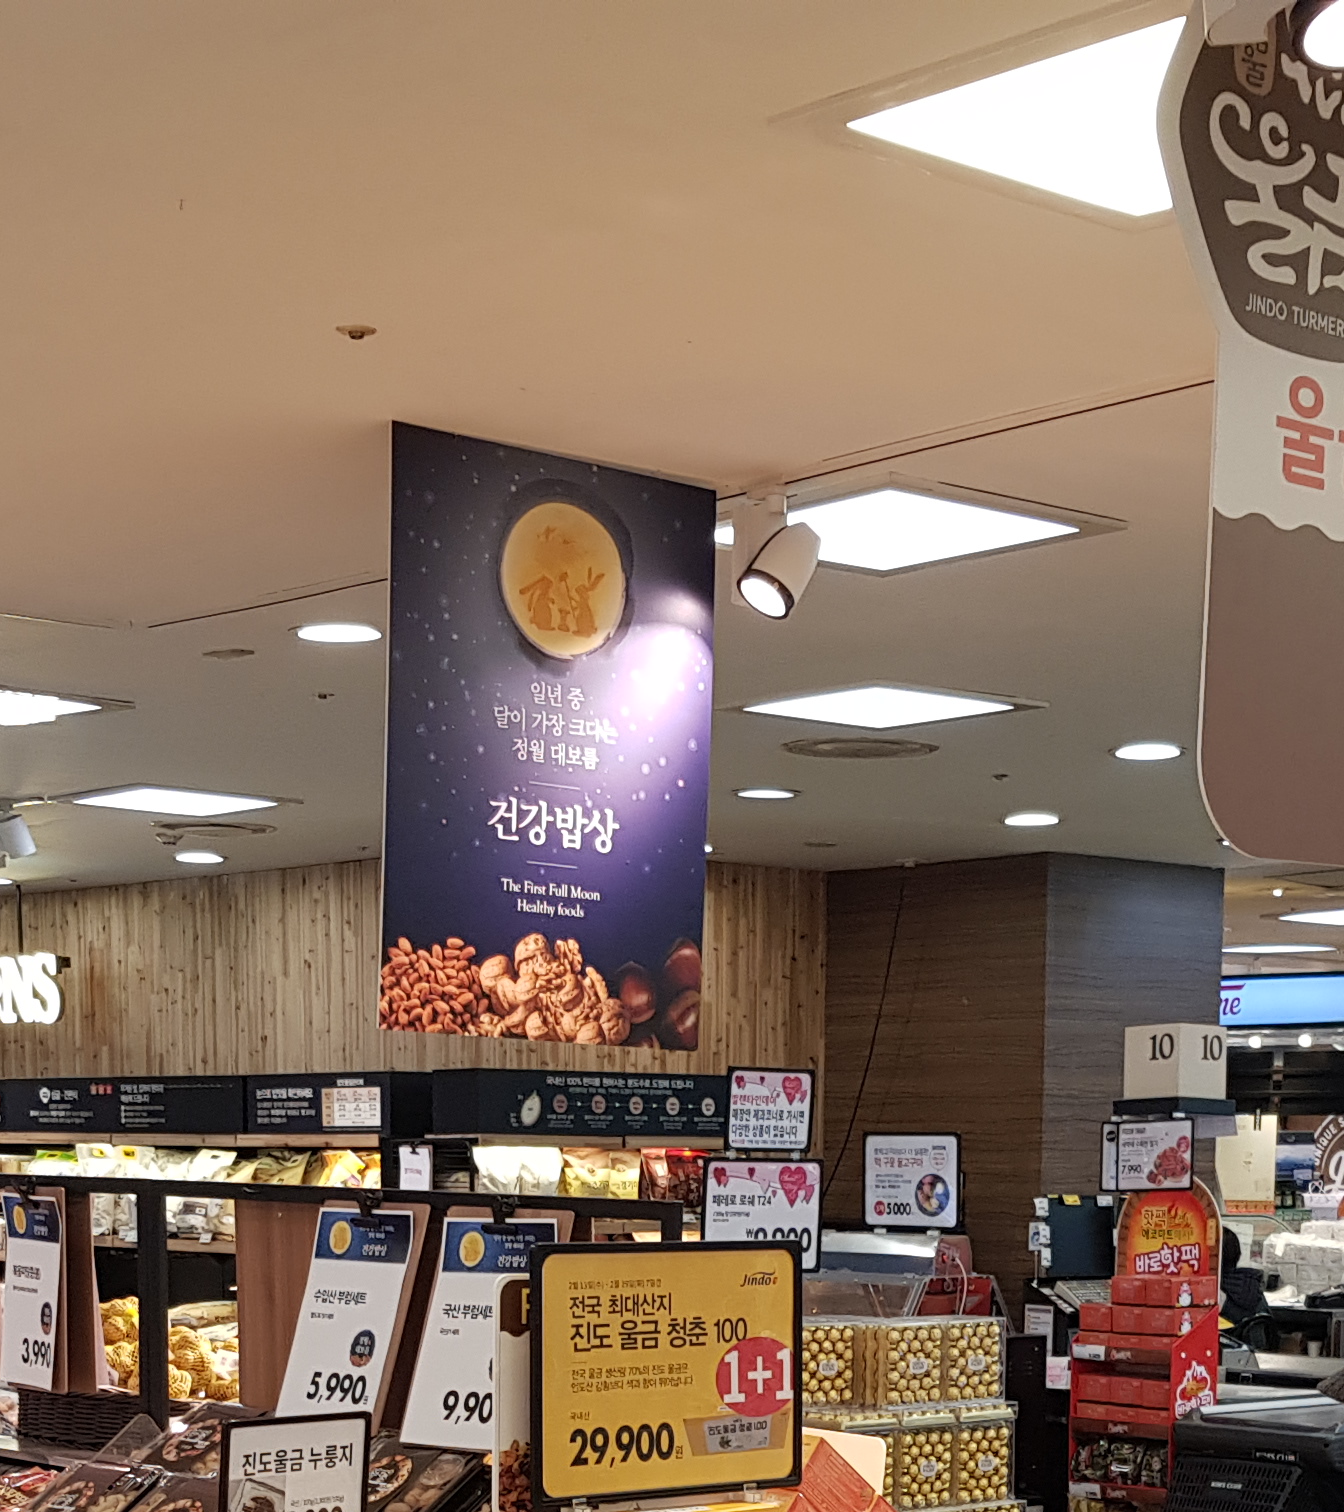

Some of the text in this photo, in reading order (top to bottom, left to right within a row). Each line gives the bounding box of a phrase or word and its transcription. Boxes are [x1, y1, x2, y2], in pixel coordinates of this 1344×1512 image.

[1245, 292, 1288, 321] JINDO
[530, 681, 585, 711] 일년 중
[493, 705, 526, 732] 달이
[531, 713, 566, 737] 가장
[512, 738, 600, 770] 정월 대보름
[487, 796, 620, 854] 건강밥상
[500, 877, 601, 901] The First Full Moon
[517, 899, 585, 918] Healthy foods
[1148, 1032, 1175, 1061] 10
[1201, 1034, 1224, 1061] 10
[569, 1292, 672, 1319] 전국 최대산지
[570, 1316, 748, 1353] 진도 울금 청춘 100
[21, 1337, 52, 1369] 3,990
[306, 1371, 367, 1406] 5,990
[723, 1347, 794, 1404] 1+1
[241, 1442, 354, 1478] 진도울금 누룽지
